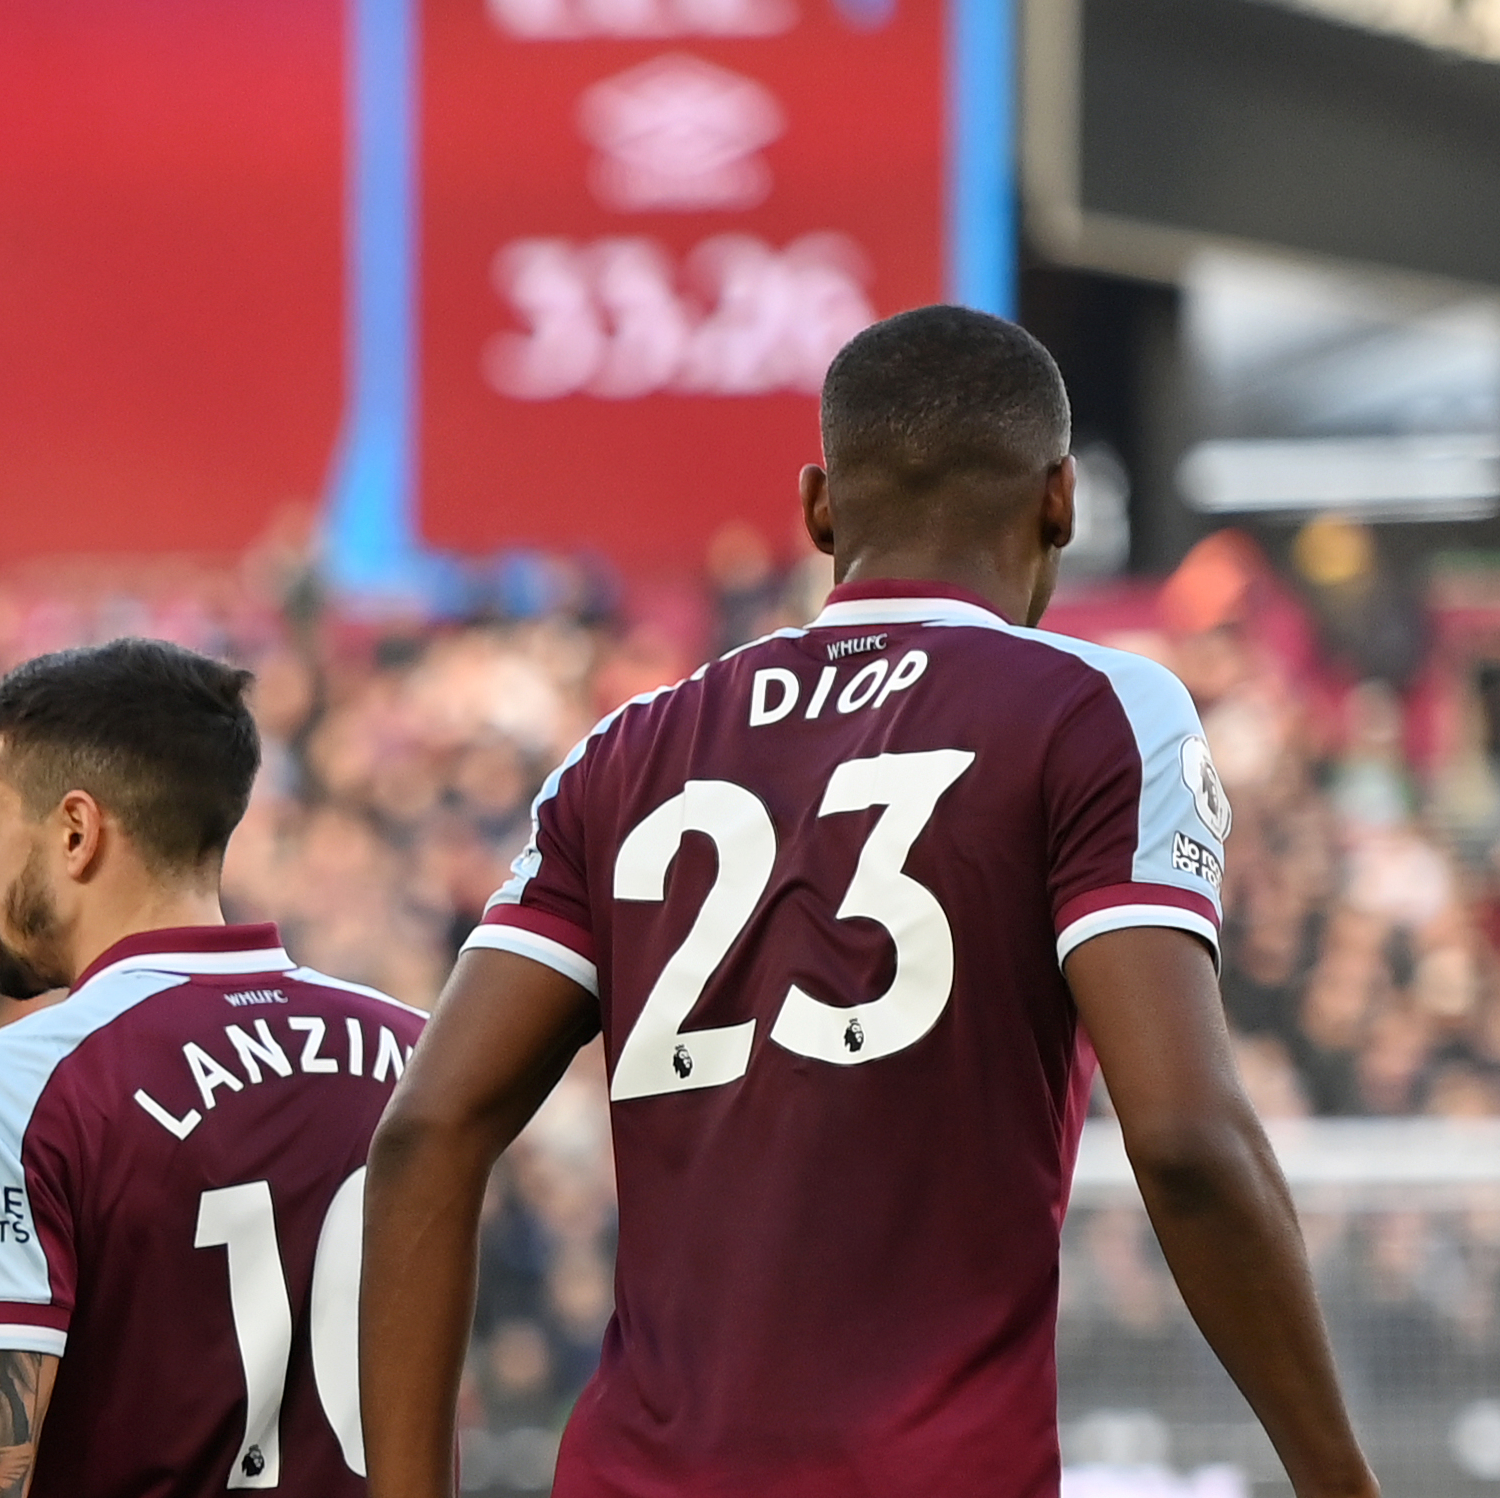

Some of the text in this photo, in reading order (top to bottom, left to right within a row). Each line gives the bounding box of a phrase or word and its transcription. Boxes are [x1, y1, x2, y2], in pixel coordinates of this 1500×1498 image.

[827, 633, 888, 661] WHUFC
[749, 650, 929, 727] DIOP
[1173, 833, 1199, 861] No
[1172, 851, 1199, 875] for
[610, 749, 976, 1101] 23
[224, 988, 289, 1008] WHUFC
